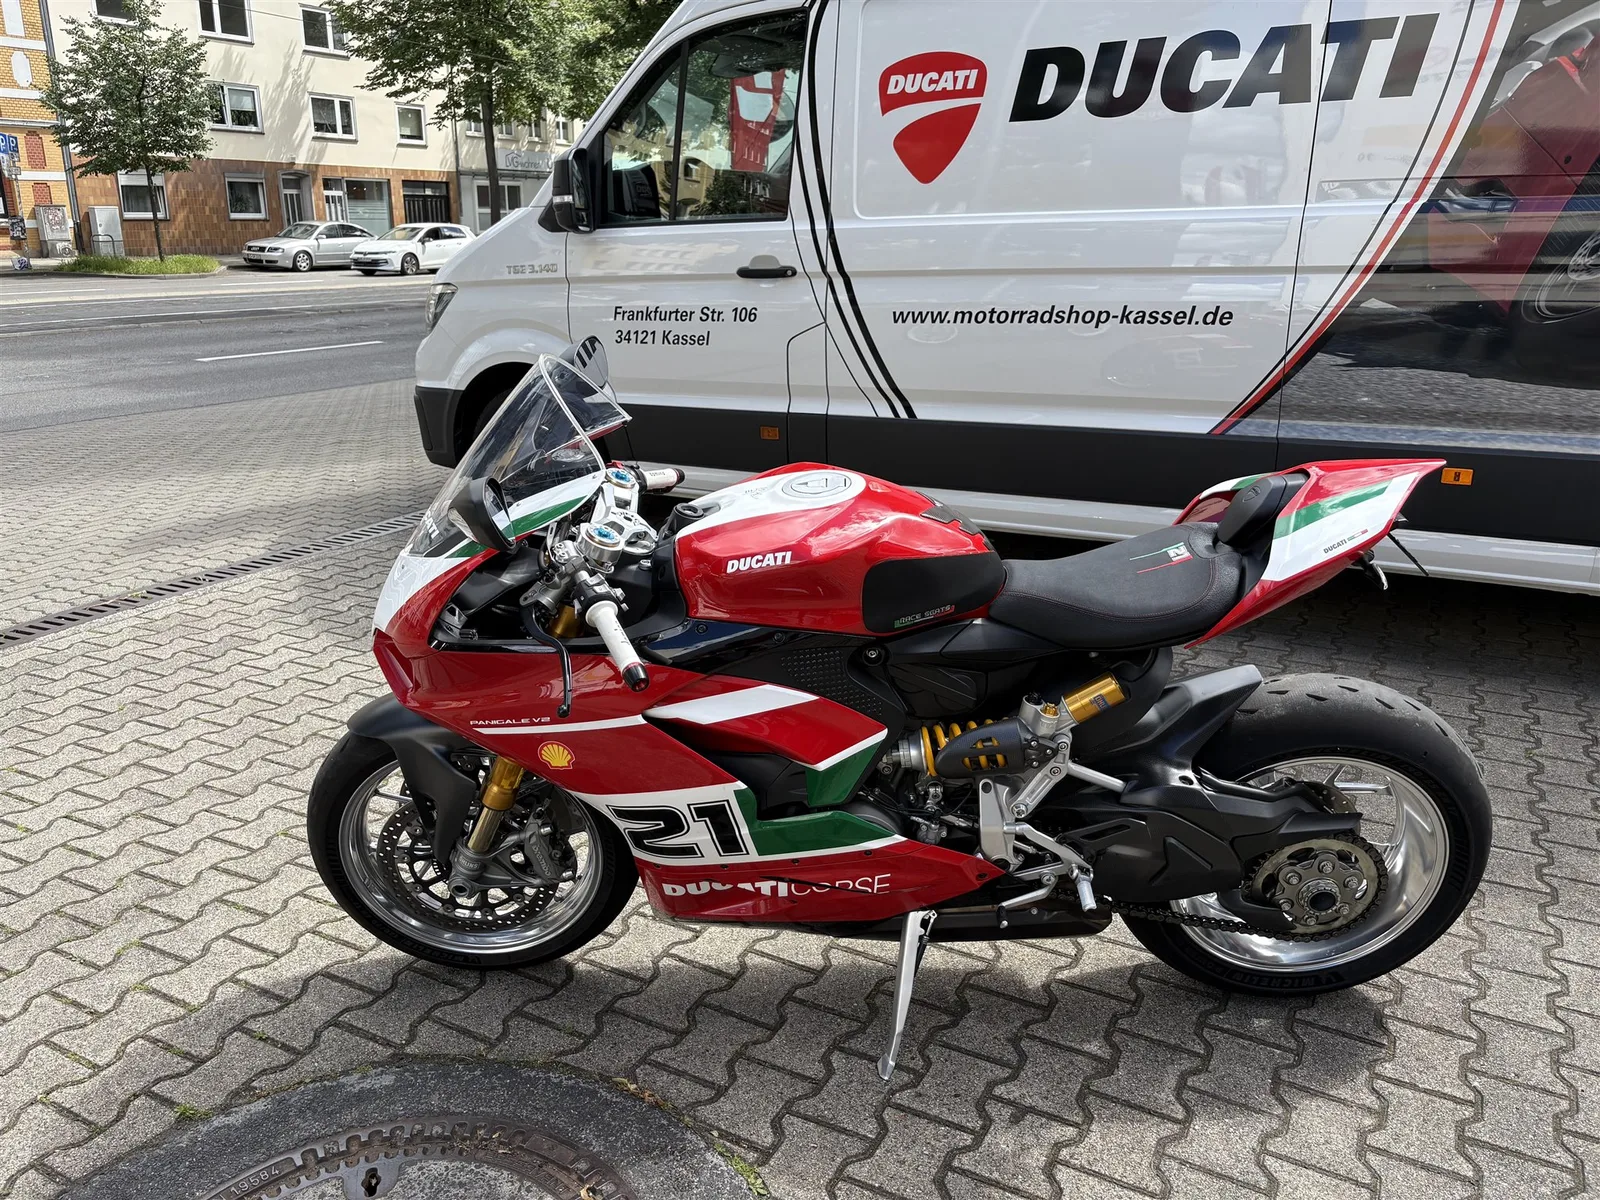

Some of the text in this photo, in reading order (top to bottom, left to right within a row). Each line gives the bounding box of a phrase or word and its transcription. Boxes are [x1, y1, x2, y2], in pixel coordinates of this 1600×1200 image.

[1009, 13, 1440, 123] DUCATI
[887, 69, 979, 94] DUCATI
[506, 263, 558, 275] TGE 3.140
[613, 306, 758, 323] Frankfurter Str. 106
[892, 305, 1234, 328] www.motorradshop-kassel.de
[615, 329, 710, 346] 34121 Kassel
[1323, 539, 1347, 554] DUCATI
[726, 550, 792, 574] DUCATI
[605, 799, 750, 858] 21
[230, 1166, 280, 1195] 19584
